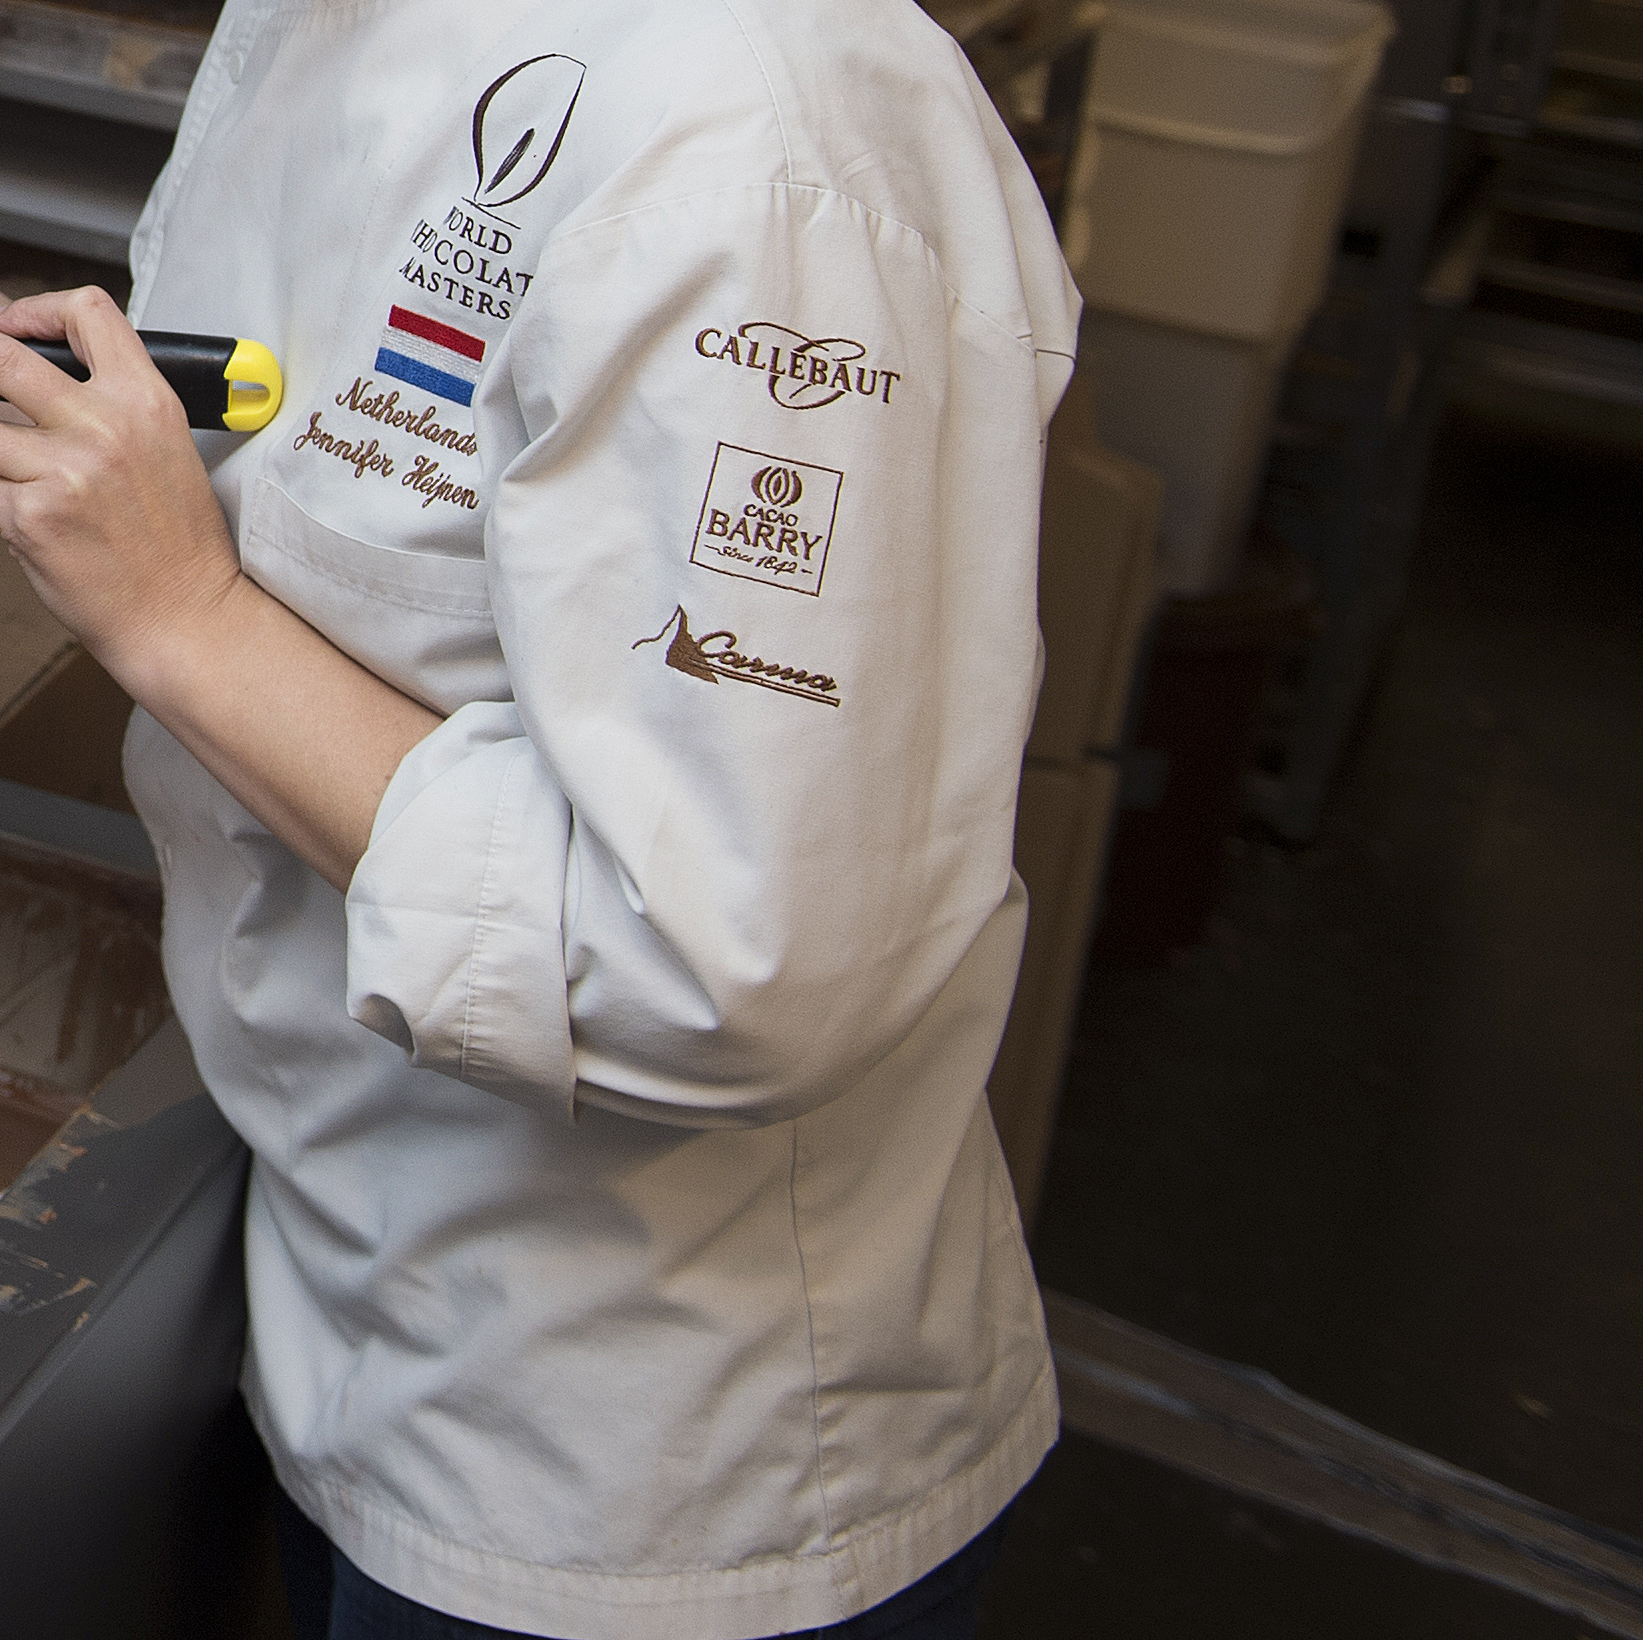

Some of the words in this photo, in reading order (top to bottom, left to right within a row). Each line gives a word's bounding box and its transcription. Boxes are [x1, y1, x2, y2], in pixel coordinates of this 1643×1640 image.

[695, 326, 902, 405] CALLEBAUT
[293, 410, 395, 480] Jennifer
[705, 508, 824, 562] BARRY
[742, 503, 799, 528] CACAO
[755, 554, 799, 576] 1842
[696, 629, 838, 693] Carma
